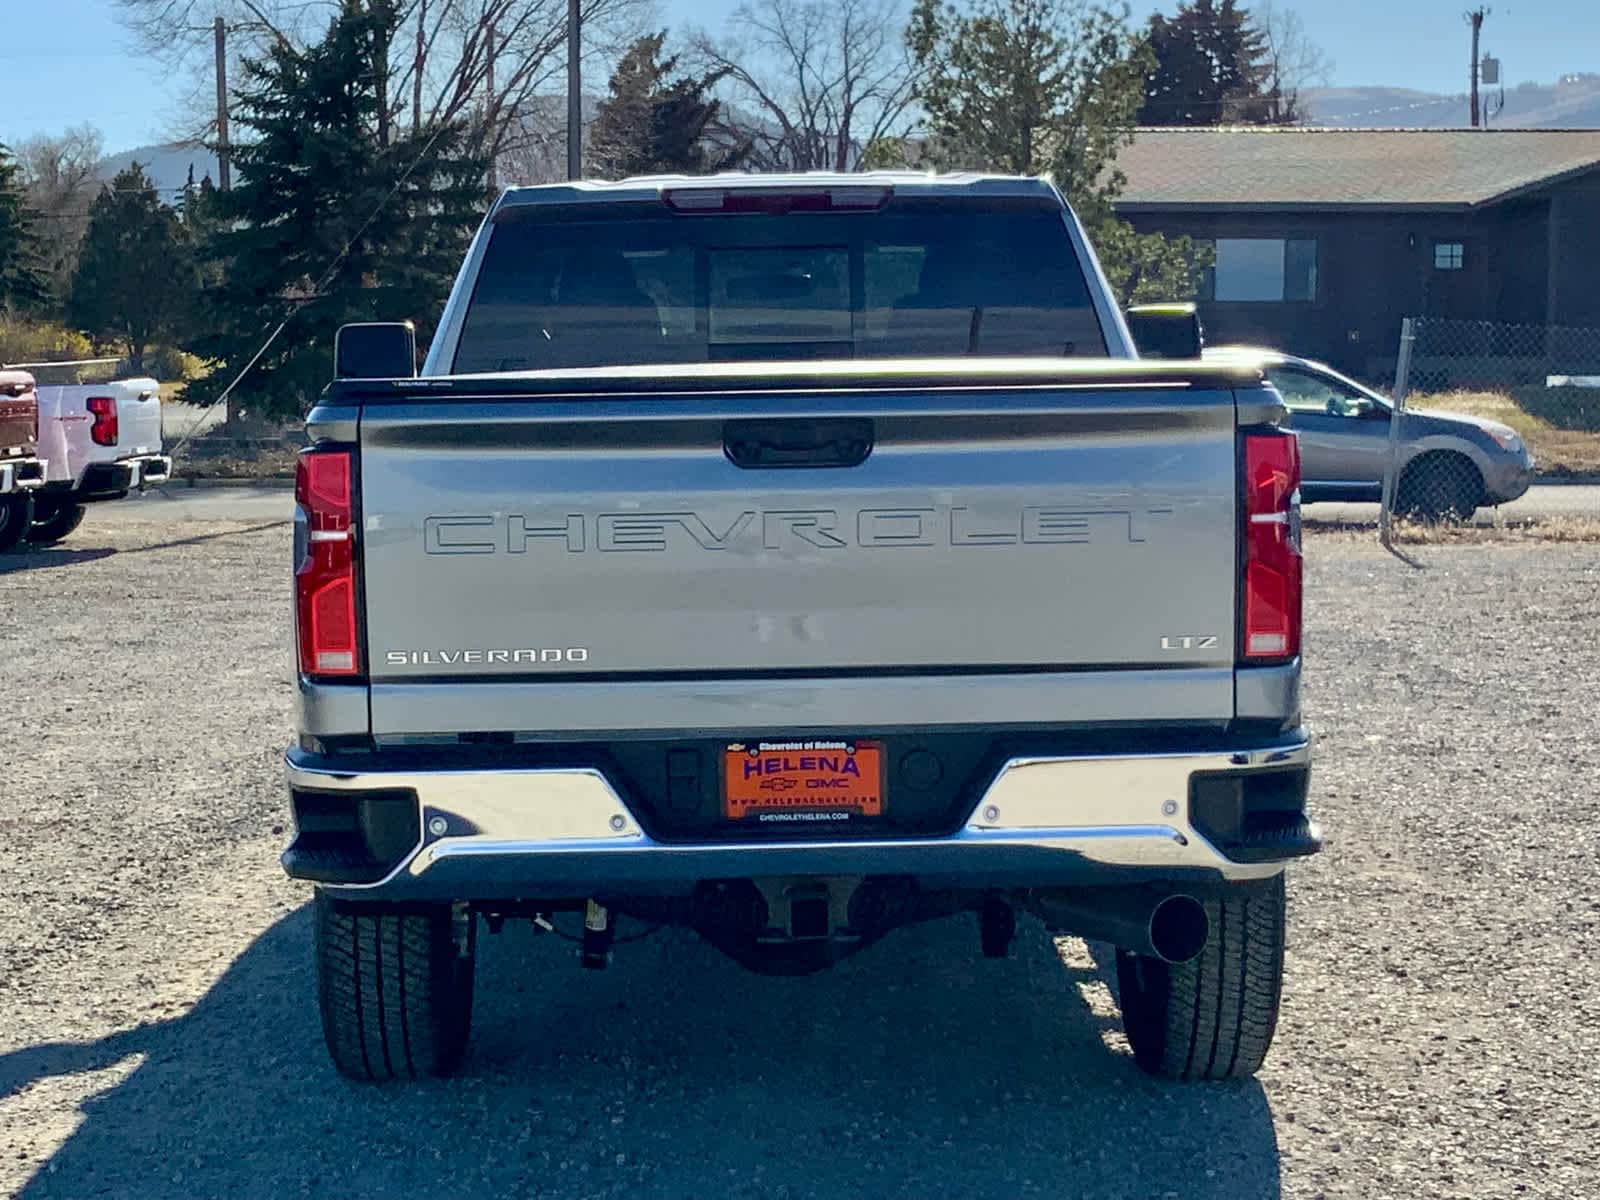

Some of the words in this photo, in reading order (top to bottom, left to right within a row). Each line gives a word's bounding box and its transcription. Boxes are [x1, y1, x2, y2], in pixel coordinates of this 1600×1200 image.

[423, 504, 1173, 555] CHEVROLET
[1160, 634, 1218, 650] LTZ
[385, 647, 589, 665] SILVERADO
[743, 757, 860, 780] HELENA
[805, 778, 850, 789] GMC
